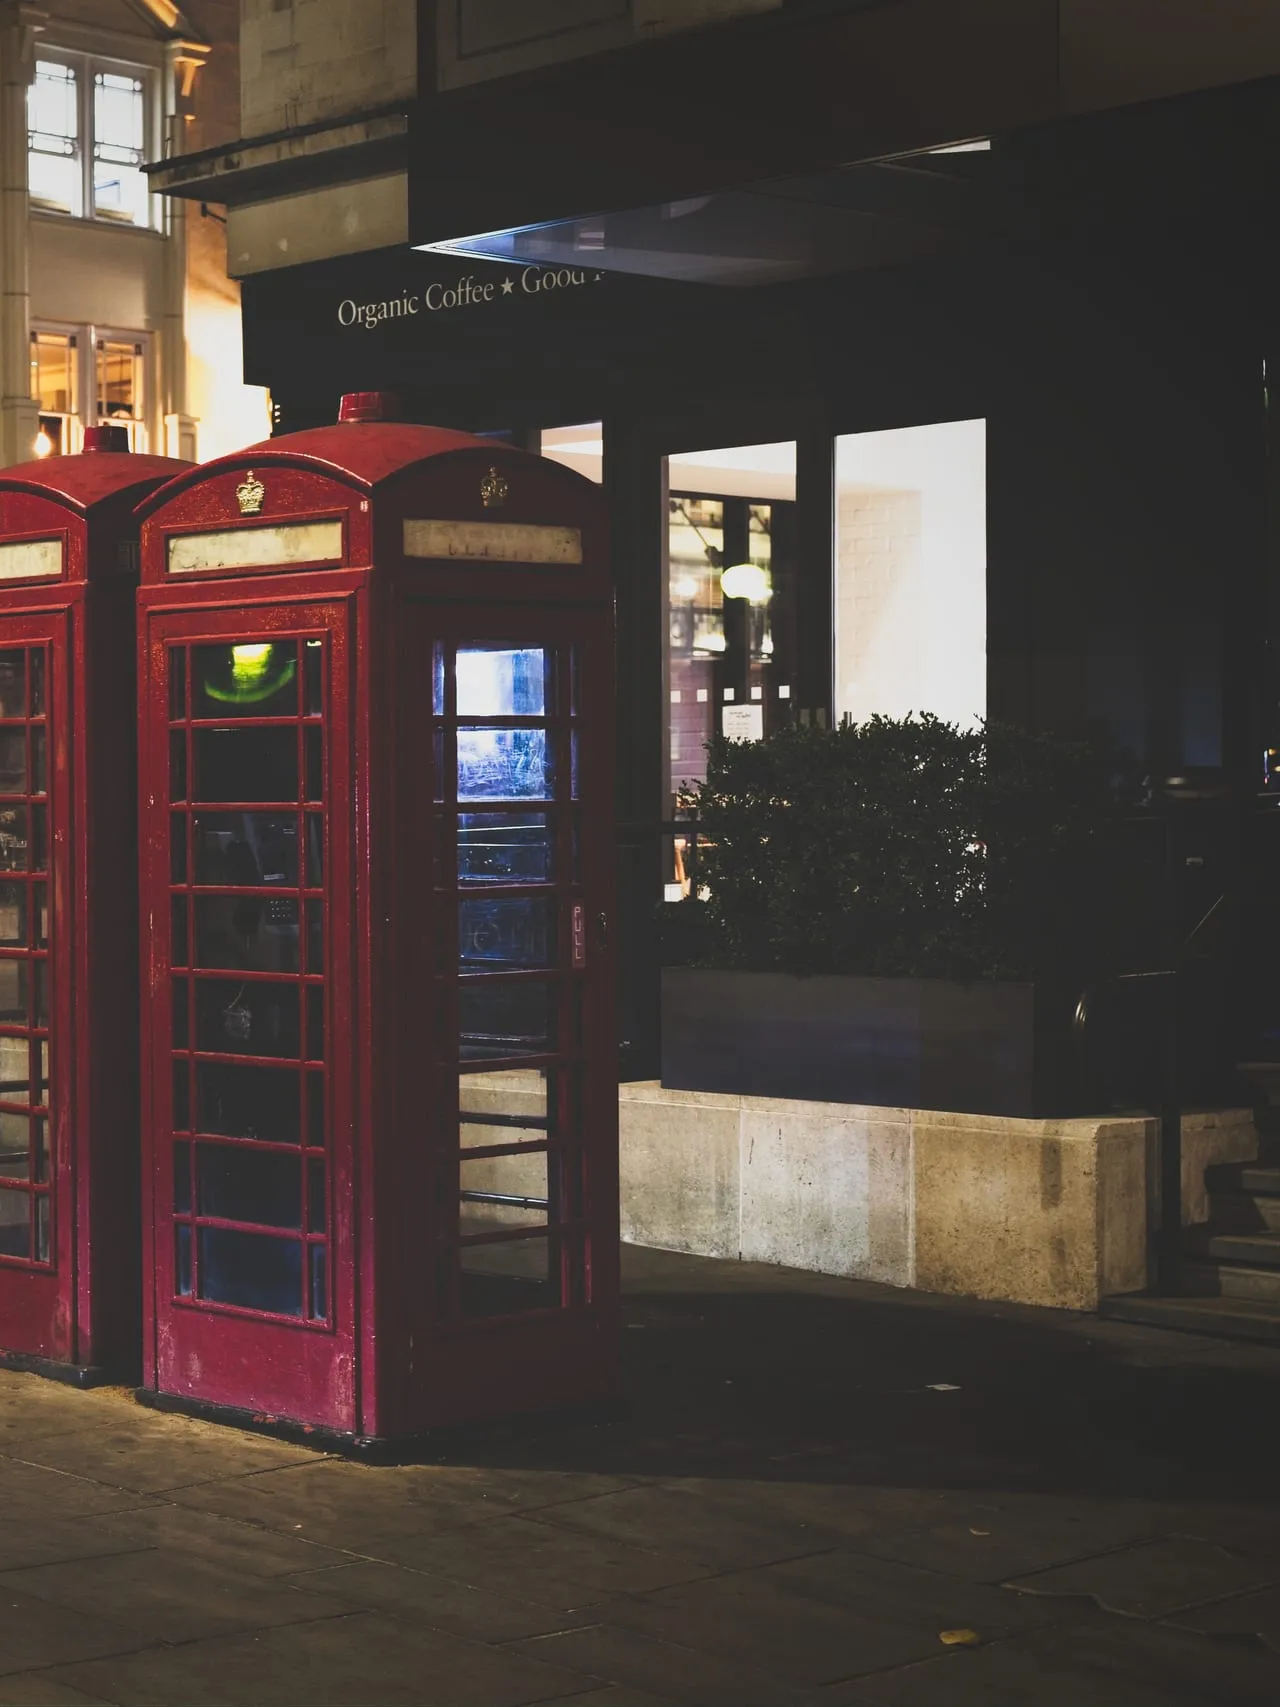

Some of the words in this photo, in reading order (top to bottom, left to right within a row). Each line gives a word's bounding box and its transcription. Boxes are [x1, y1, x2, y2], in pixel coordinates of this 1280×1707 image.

[337, 288, 419, 329] Organic
[425, 275, 495, 312] Coffee
[574, 906, 583, 959] PULL
